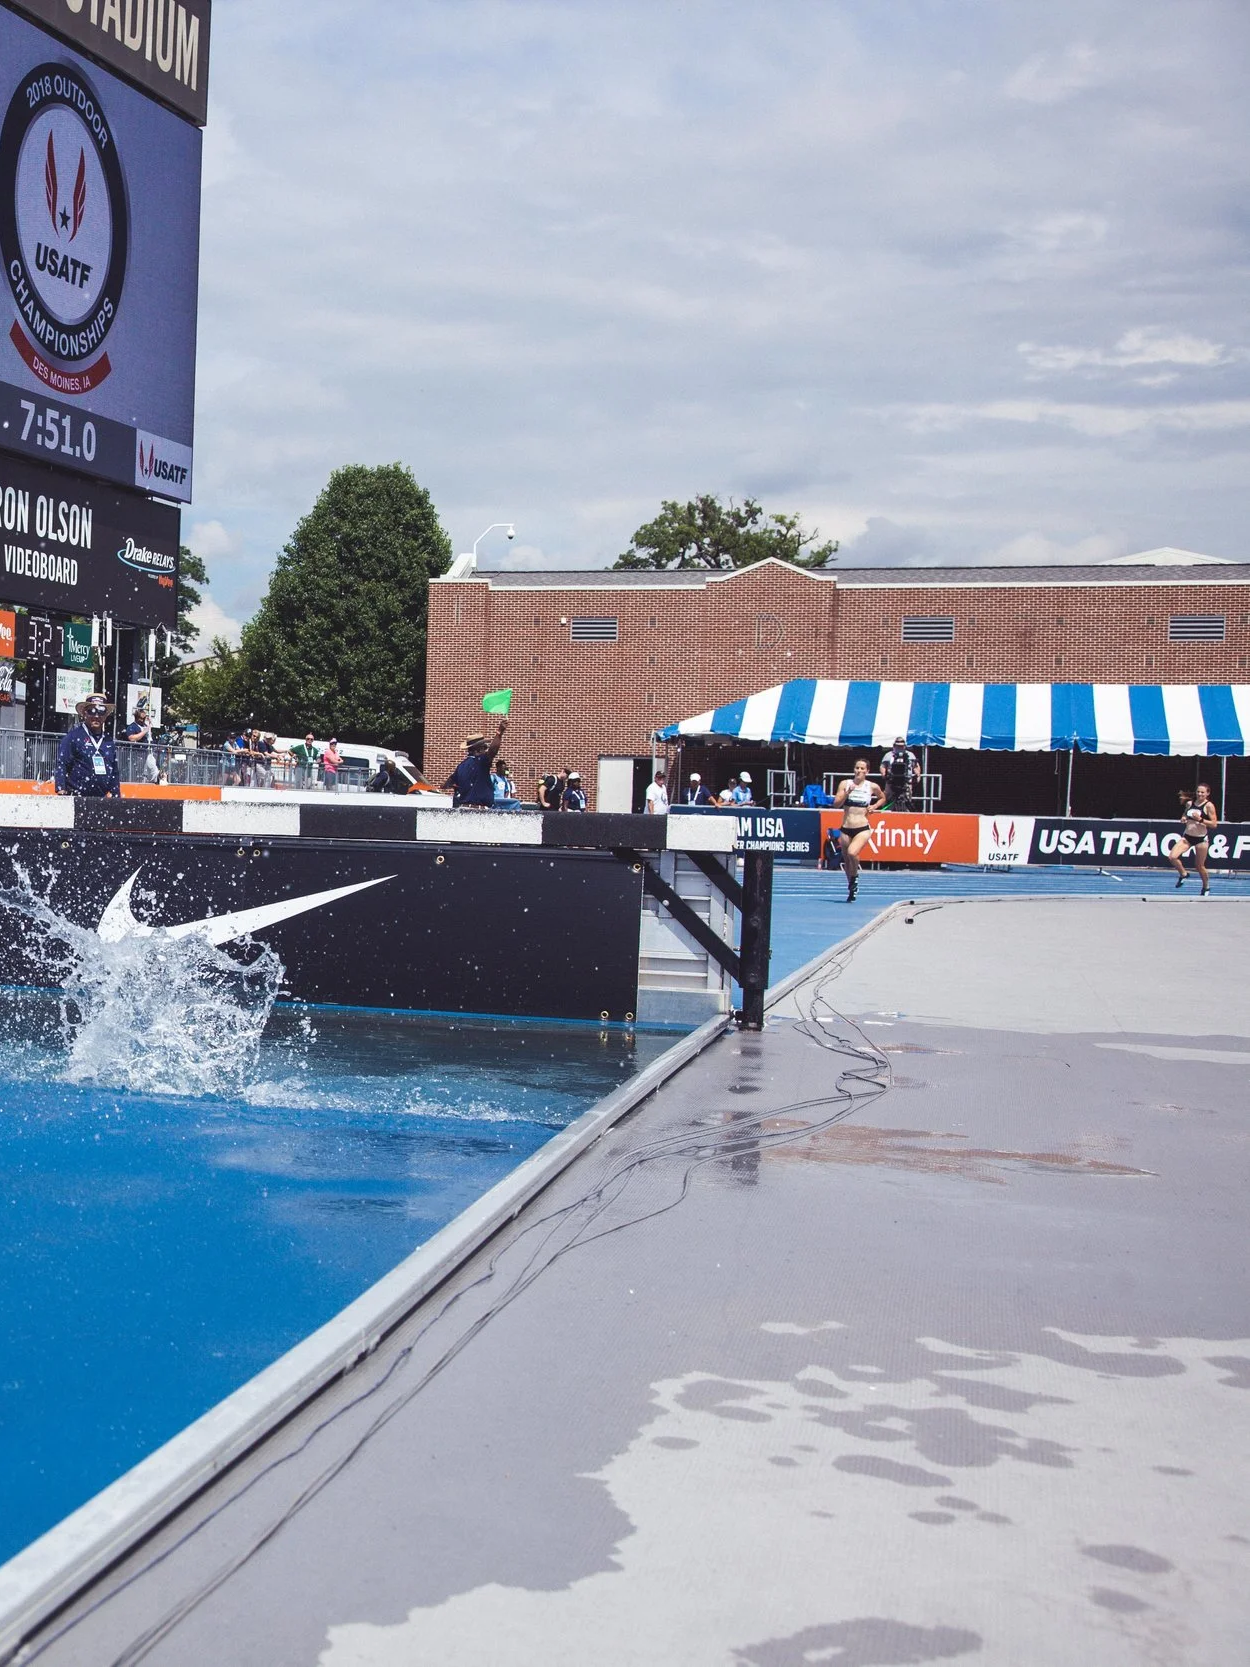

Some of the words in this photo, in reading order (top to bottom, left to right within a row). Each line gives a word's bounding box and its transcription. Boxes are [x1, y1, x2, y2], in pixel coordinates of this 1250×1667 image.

[66, 0, 199, 91] ADIUM
[26, 75, 52, 108] 2018
[54, 74, 108, 149] OUTDOOR
[35, 242, 93, 288] USATF
[10, 259, 114, 356] CHAMPIONSHIPS
[32, 356, 49, 379] DES
[50, 371, 82, 392] MOINES,
[83, 377, 91, 388] IA
[20, 399, 96, 461] 7:51.0
[153, 458, 189, 485] USATF
[35, 495, 92, 549] OLSON
[4, 544, 78, 586] VIDEOBOARD
[124, 537, 152, 564] Drake
[152, 552, 174, 569] RELAYS
[70, 639, 91, 660] Mercy
[756, 817, 784, 838] USA
[1038, 829, 1095, 855] USA
[1208, 834, 1229, 859] &
[745, 840, 785, 852] CHAMPIONS
[786, 841, 810, 853] SERIES
[988, 853, 1019, 862] USATF
